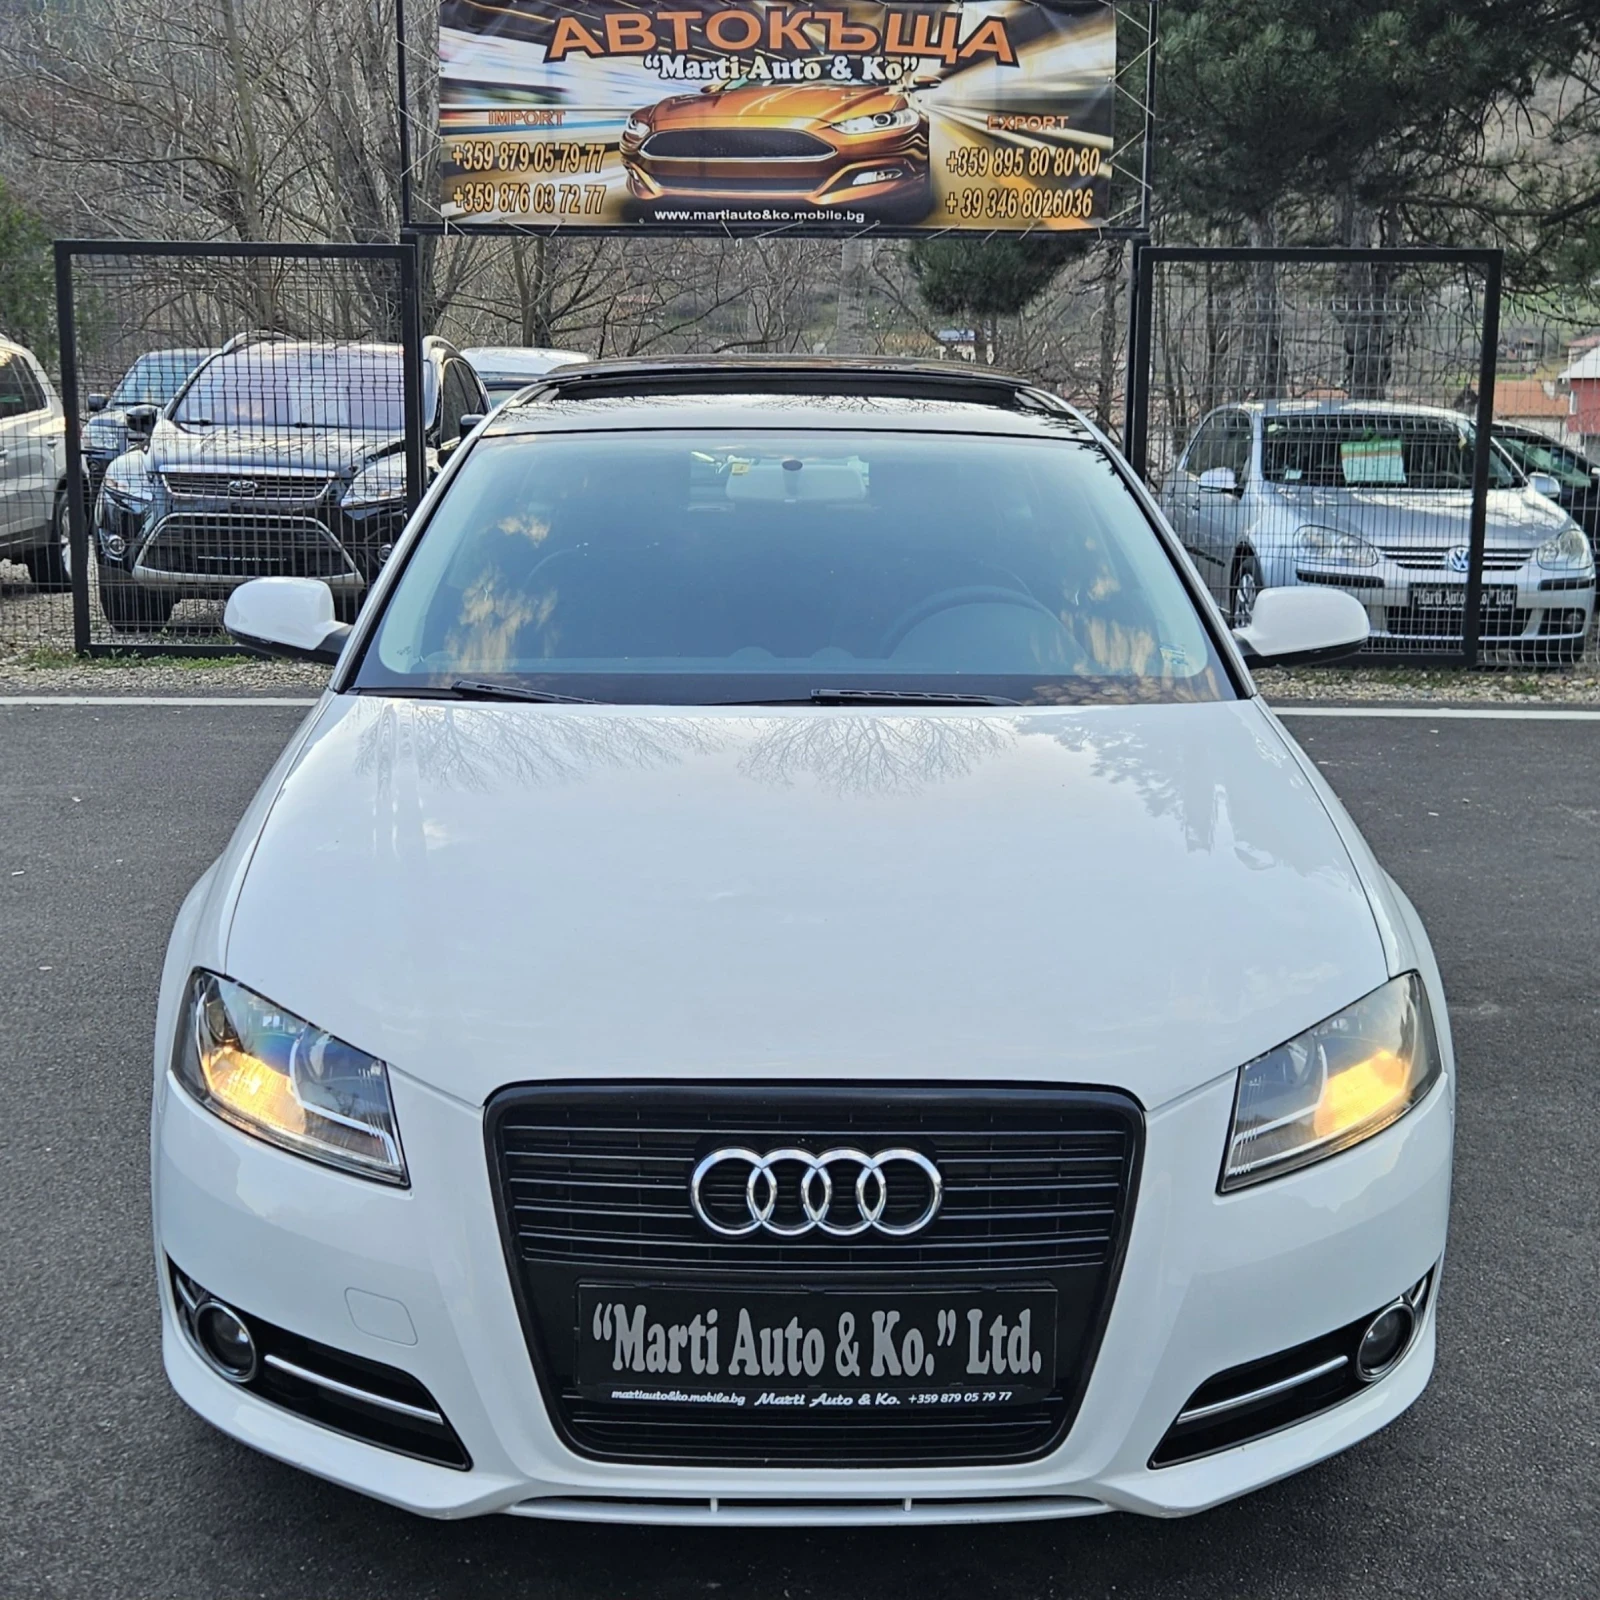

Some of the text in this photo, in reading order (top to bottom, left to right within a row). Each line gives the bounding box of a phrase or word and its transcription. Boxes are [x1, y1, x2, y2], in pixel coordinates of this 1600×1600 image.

[546, 9, 1017, 65] АВТОКЪЩА
[644, 53, 918, 80] “Marti Auto & Ko”
[488, 110, 565, 126] IMPORT
[986, 115, 1069, 131] EXPORT
[452, 141, 606, 173] +359 879 05 79 77
[946, 147, 1100, 177] +359 895 80 80 80
[453, 182, 607, 214] +359 876 03 72 77
[986, 188, 1018, 218] 346
[1021, 188, 1093, 218] 8026036
[654, 210, 865, 223] www.martiauto&ko.mobile.bg
[592, 1302, 720, 1375] “Marti
[728, 1307, 826, 1377] Auto
[835, 1311, 860, 1377] &
[966, 1308, 1042, 1375] Ltd.
[754, 1392, 806, 1407] Marti
[809, 1393, 853, 1408] Auto
[858, 1394, 871, 1405] &
[875, 1393, 901, 1405] Ko.
[908, 1394, 939, 1404] +359
[940, 1393, 962, 1404] 879
[964, 1392, 980, 1403] 05
[981, 1391, 997, 1402] 79
[998, 1391, 1013, 1401] 77
